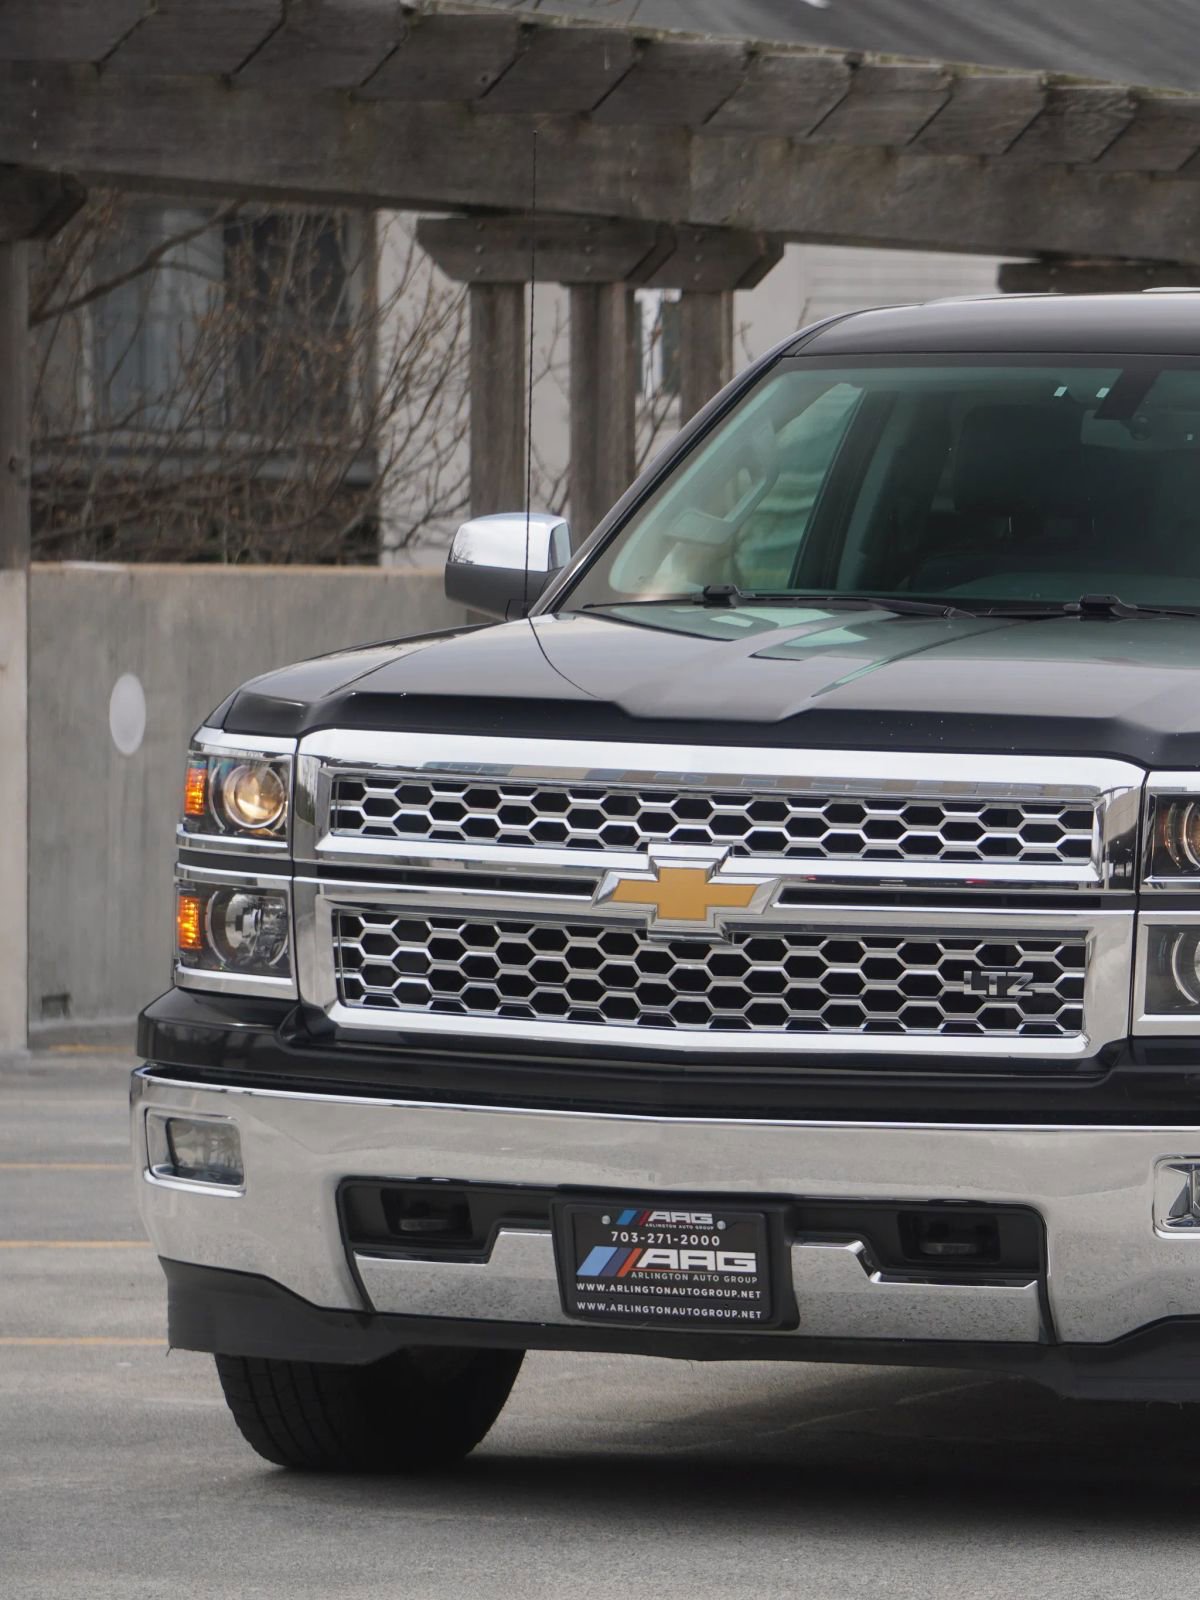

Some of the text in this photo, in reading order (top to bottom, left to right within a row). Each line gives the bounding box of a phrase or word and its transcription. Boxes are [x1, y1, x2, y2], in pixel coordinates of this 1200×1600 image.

[963, 970, 1034, 996] LTZ
[611, 1231, 720, 1246] 703-271-2000
[631, 1271, 758, 1284] ARLINGTON AUTO GROUP
[576, 1283, 761, 1299] WWW.ARLINGTONAUTOGROUP.NET
[577, 1302, 762, 1319] WWW.ARLINGTONAUTOGROUP.NET
